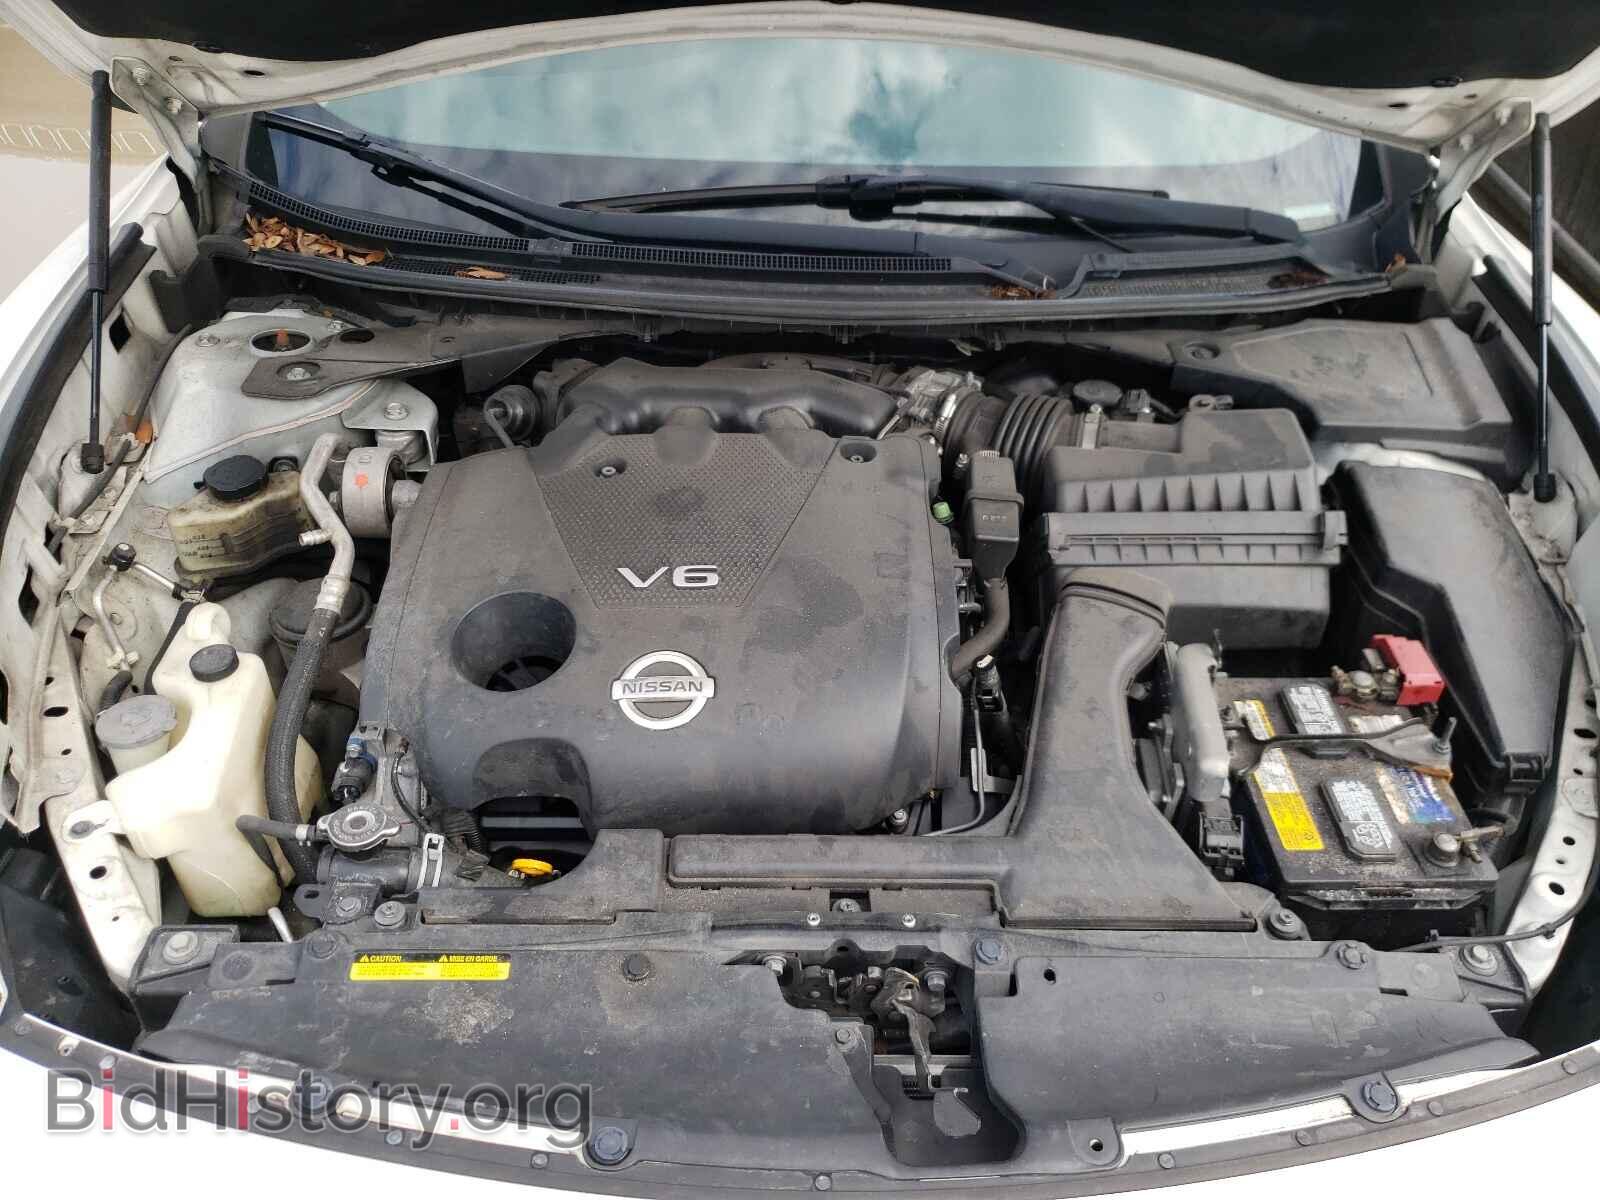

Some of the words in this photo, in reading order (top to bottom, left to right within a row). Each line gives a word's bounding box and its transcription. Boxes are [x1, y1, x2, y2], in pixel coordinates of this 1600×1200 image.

[617, 565, 719, 588] V6
[622, 680, 703, 695] NISSAN
[370, 955, 402, 963] CAUTION
